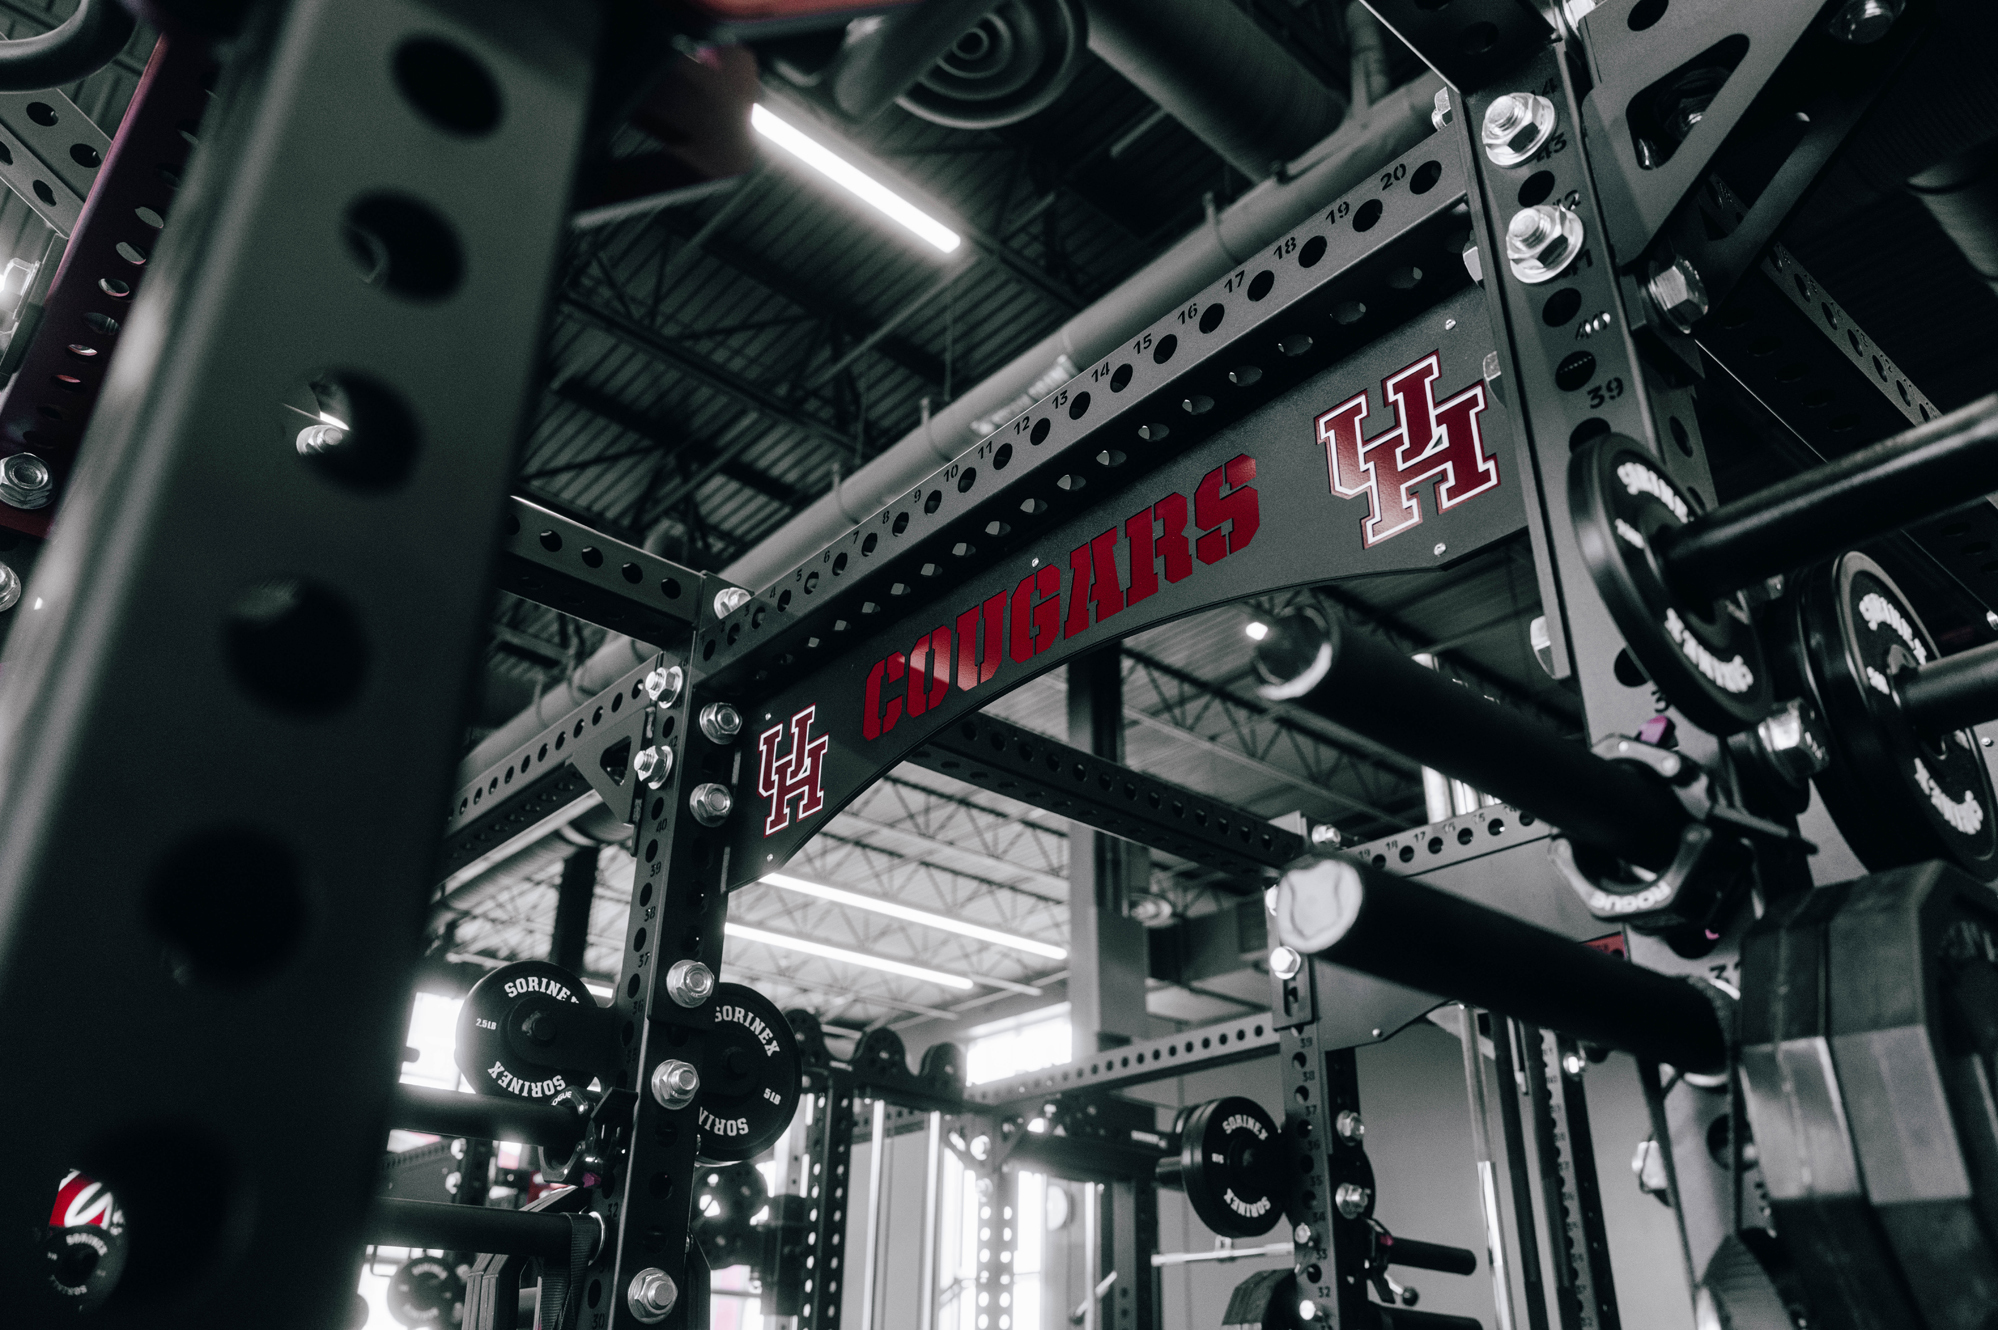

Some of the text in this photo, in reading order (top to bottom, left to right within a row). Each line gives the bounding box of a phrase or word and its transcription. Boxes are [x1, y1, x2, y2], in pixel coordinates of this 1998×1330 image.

[1575, 311, 1611, 341] 40
[744, 602, 751, 618] 3
[769, 585, 777, 599] 4
[795, 568, 803, 582] 5
[823, 550, 831, 564] 6
[852, 530, 860, 545] 7
[882, 510, 890, 524] 8
[914, 489, 921, 503] 9
[943, 464, 959, 483] 10
[977, 441, 993, 460] 11
[1013, 416, 1030, 435] 12
[1051, 390, 1069, 410] 13
[1091, 361, 1111, 382] 14
[1132, 333, 1153, 355] 15
[1176, 302, 1199, 325] 16
[1223, 269, 1246, 294] 17
[1272, 236, 1297, 261] 18
[1324, 201, 1351, 226] 19
[1379, 162, 1407, 191] 20
[1587, 377, 1623, 409] 39
[862, 453, 1259, 741] COUGARS
[657, 818, 668, 832] 40
[1413, 831, 1426, 843] 17
[650, 861, 661, 877] 39
[1586, 881, 1671, 913] ROGUE
[644, 905, 656, 922] 38
[638, 952, 650, 968] 37
[632, 999, 644, 1016] 36
[487, 1060, 566, 1098] SORINEX
[550, 1090, 573, 1106] OGUE
[763, 1087, 782, 1105] 5LB
[1305, 1105, 1318, 1116] 37
[607, 1201, 619, 1218] 32
[1318, 1286, 1331, 1298] 32
[592, 1312, 605, 1330] 30
